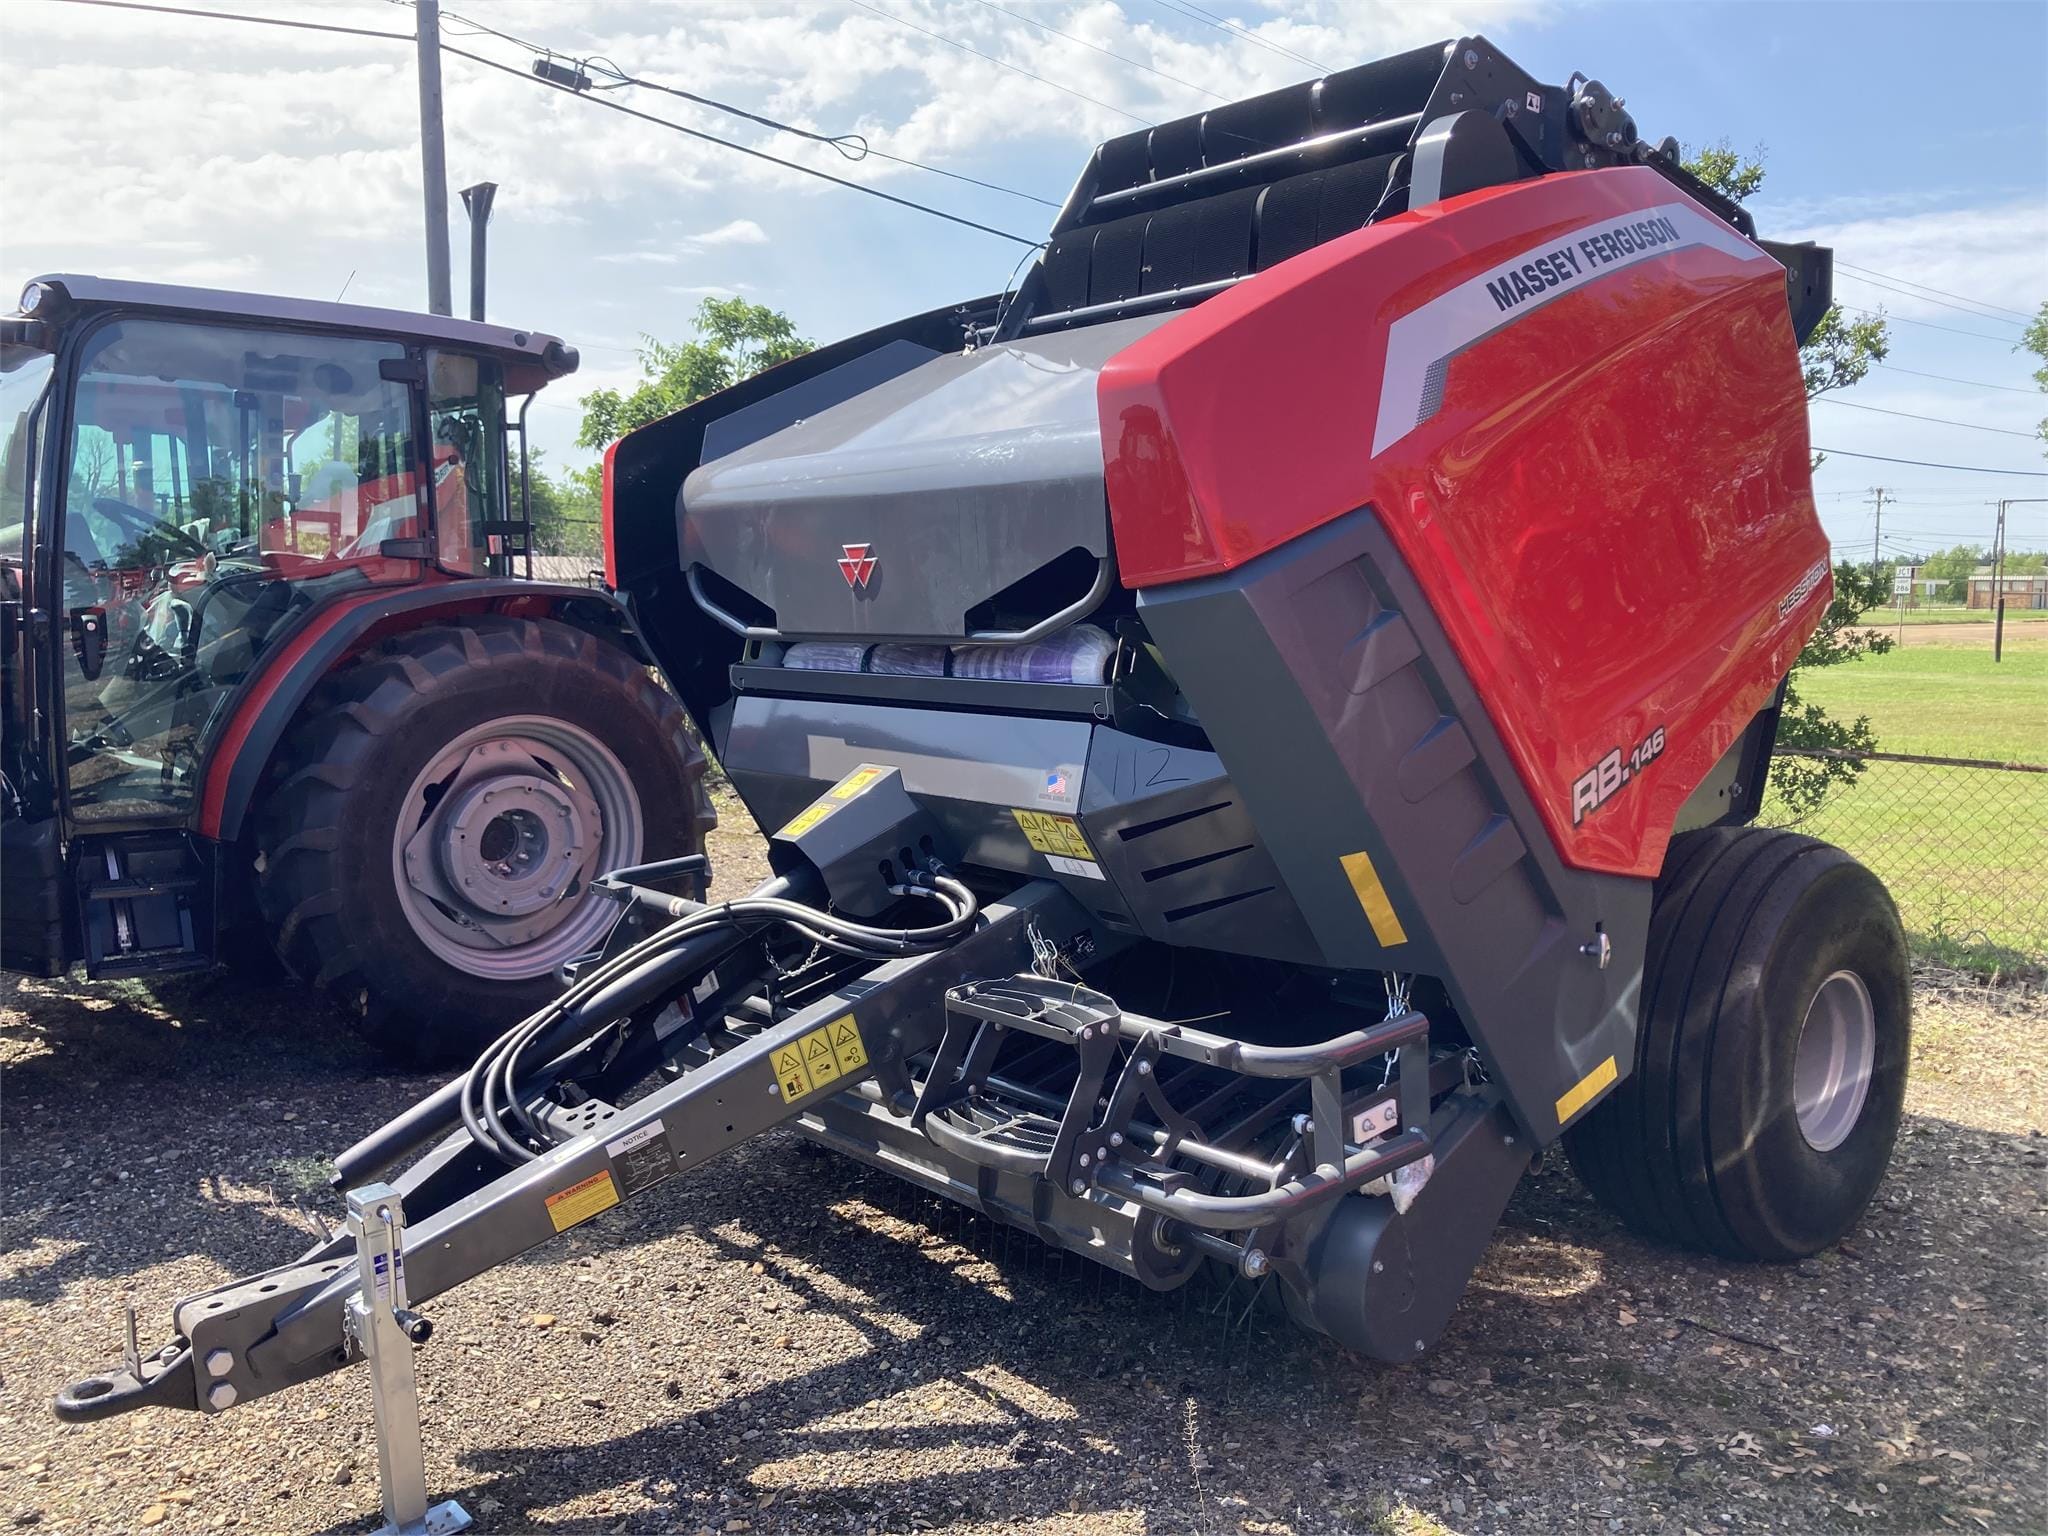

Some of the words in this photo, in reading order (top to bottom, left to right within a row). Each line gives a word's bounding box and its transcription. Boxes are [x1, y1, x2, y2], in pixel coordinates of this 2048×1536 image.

[1486, 245, 1583, 311] MASSEY
[1580, 217, 1680, 268] FERGUSON
[1897, 567, 1910, 576] JCT
[1779, 559, 1828, 619] HESSTON
[1112, 747, 1191, 796] 112
[623, 1130, 648, 1147] NOTICE
[564, 1176, 599, 1196] WARNING
